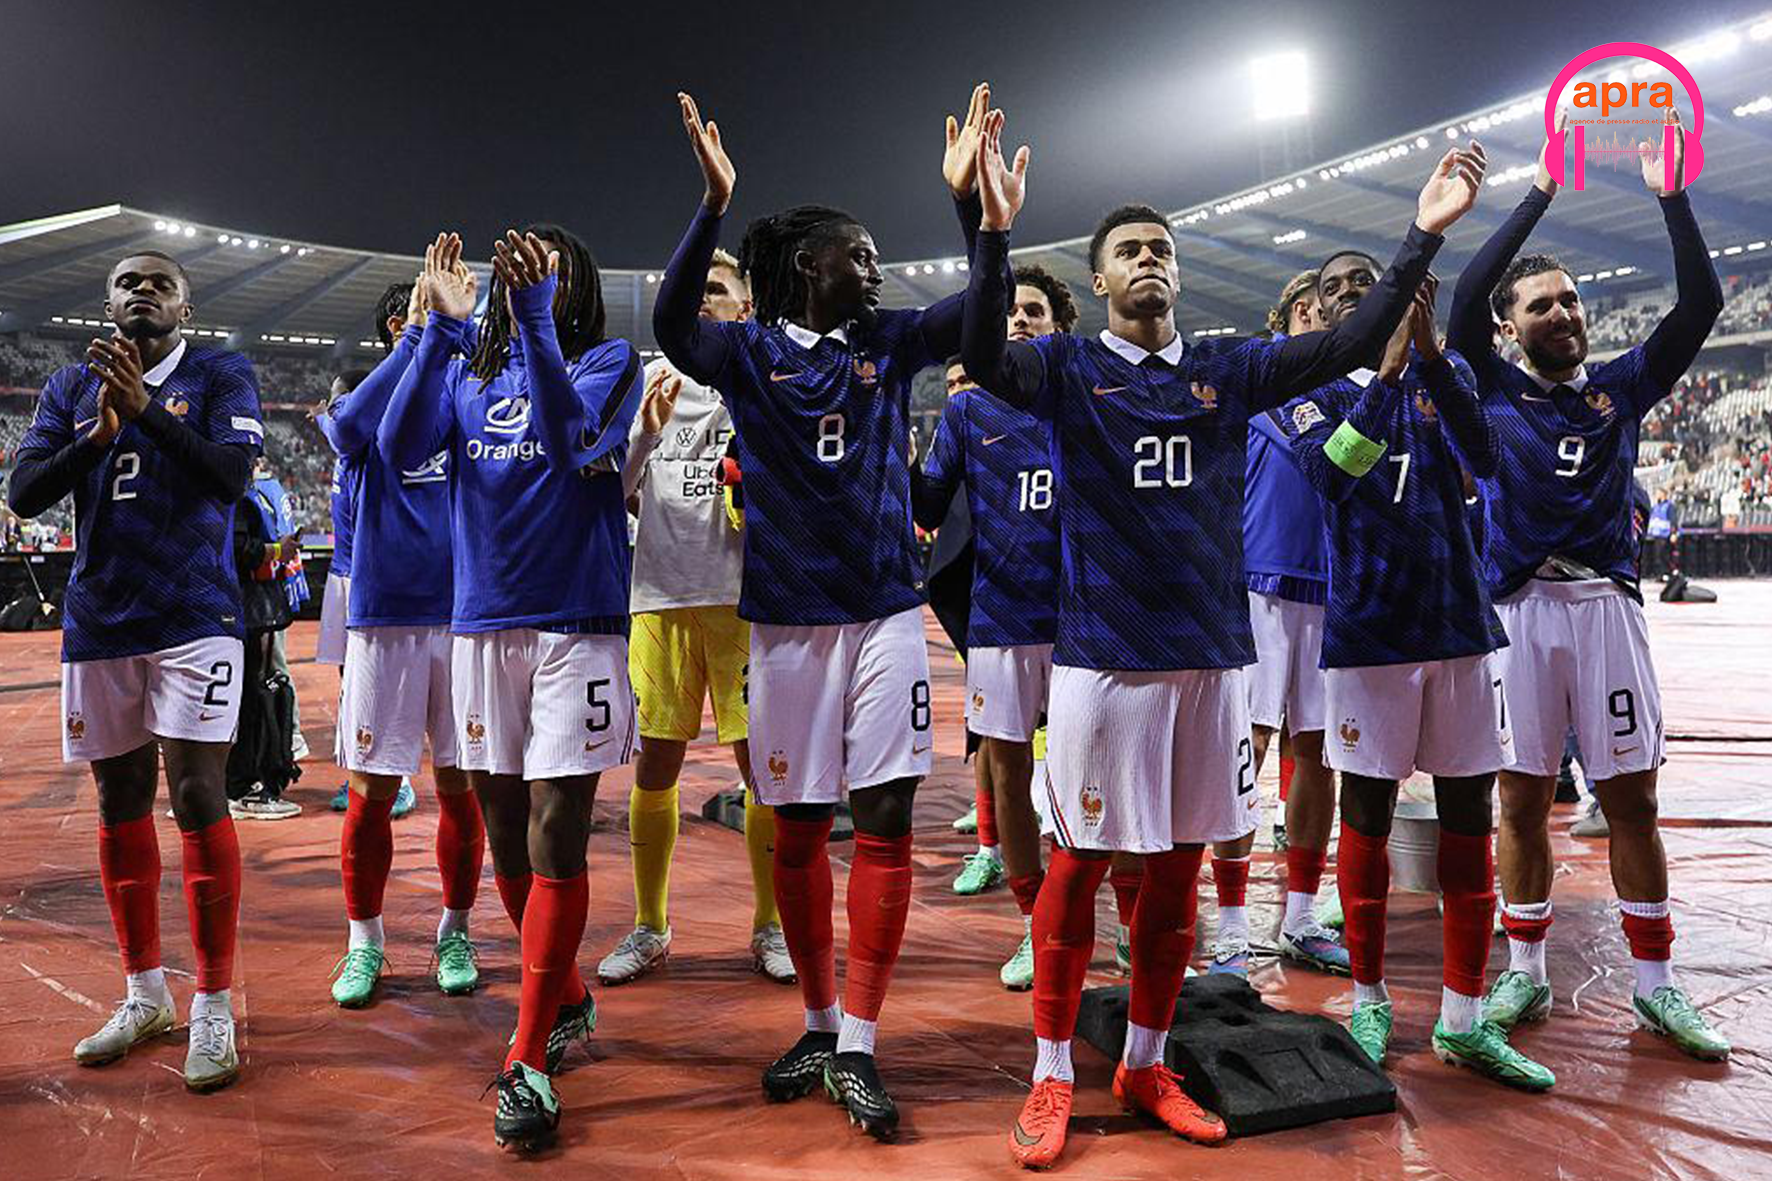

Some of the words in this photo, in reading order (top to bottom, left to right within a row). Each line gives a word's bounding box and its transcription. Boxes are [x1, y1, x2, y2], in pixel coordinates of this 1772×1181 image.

[817, 413, 845, 462] 8
[1134, 435, 1193, 488] 20
[1555, 436, 1586, 477] 9
[112, 452, 141, 500] 2
[683, 481, 725, 497] Eats
[1017, 469, 1053, 512] 18
[1389, 453, 1411, 503] 7
[204, 661, 232, 706] 2
[585, 678, 611, 732] 5
[911, 680, 931, 732] 8
[1608, 689, 1637, 737] 9
[1238, 738, 1254, 796] 2
